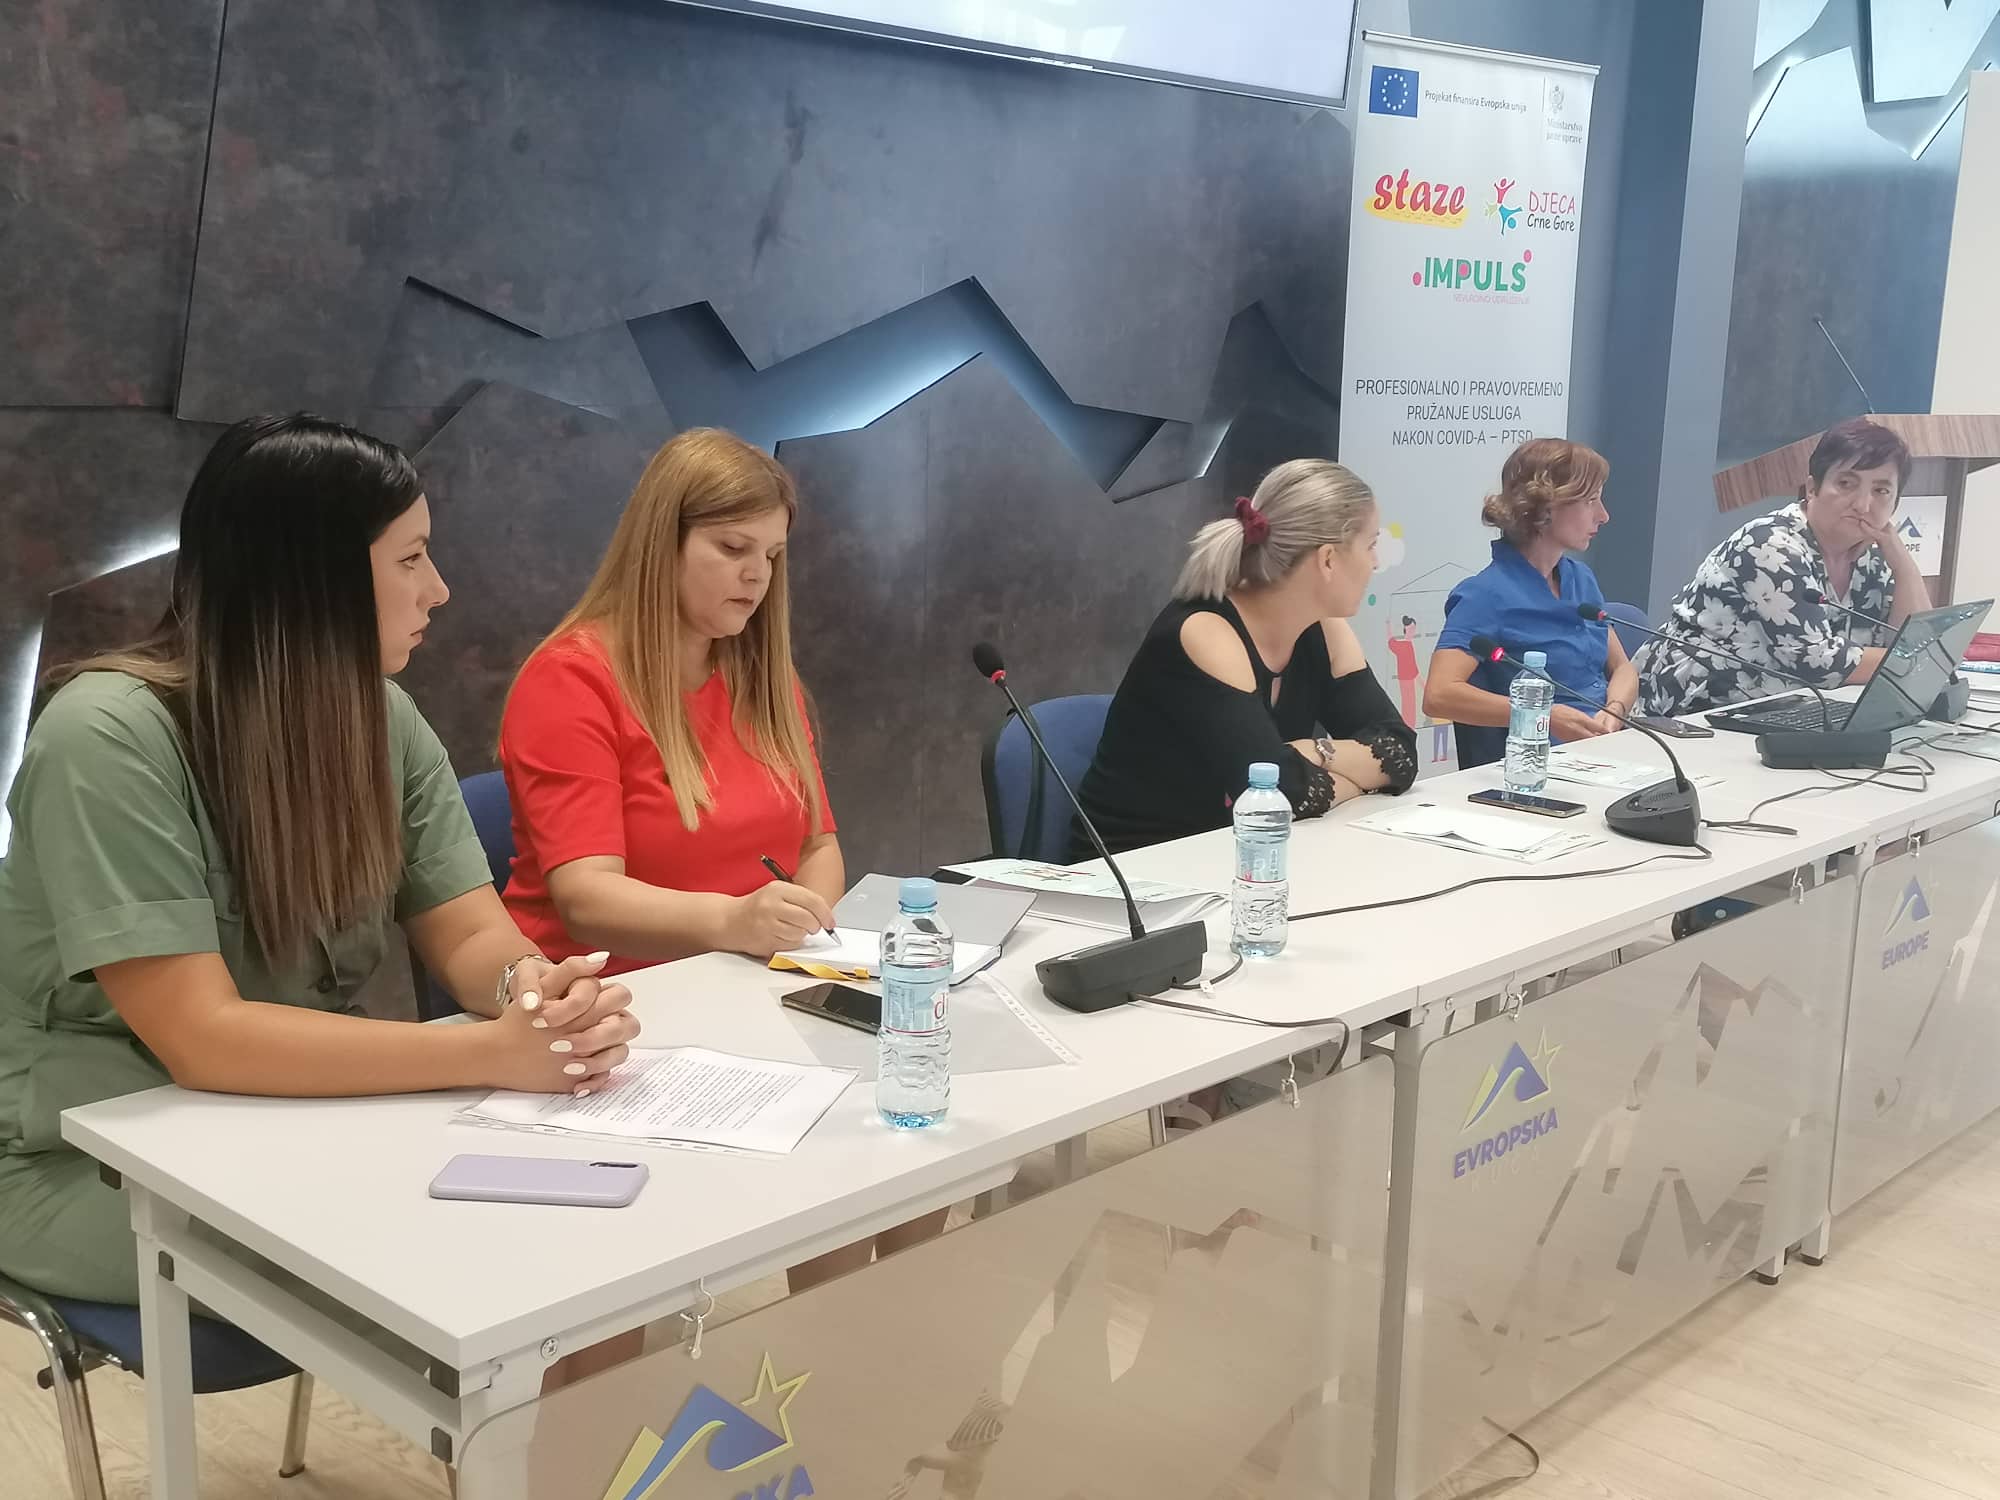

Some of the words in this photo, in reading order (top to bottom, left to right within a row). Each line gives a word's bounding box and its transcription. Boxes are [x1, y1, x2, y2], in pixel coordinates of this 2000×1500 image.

[1425, 89, 1452, 103] Projekat
[1453, 93, 1480, 106] finansira
[1480, 97, 1510, 110] Evropska
[1373, 168, 1465, 216] staze
[1529, 190, 1576, 215] DJECA
[1527, 213, 1551, 229] Crne
[1553, 215, 1575, 232] Gore
[1424, 256, 1527, 293] IMPULS
[1355, 379, 1460, 396] PROFESIONALNO
[1469, 380, 1564, 397] PRAVOVREMENO
[1407, 402, 1470, 421] PRUŽANJE
[1472, 405, 1522, 421] USLUGA
[1392, 430, 1434, 446] NAKON
[1436, 430, 1486, 446] COVID-A
[1453, 1106, 1559, 1180] EVROPSKA
